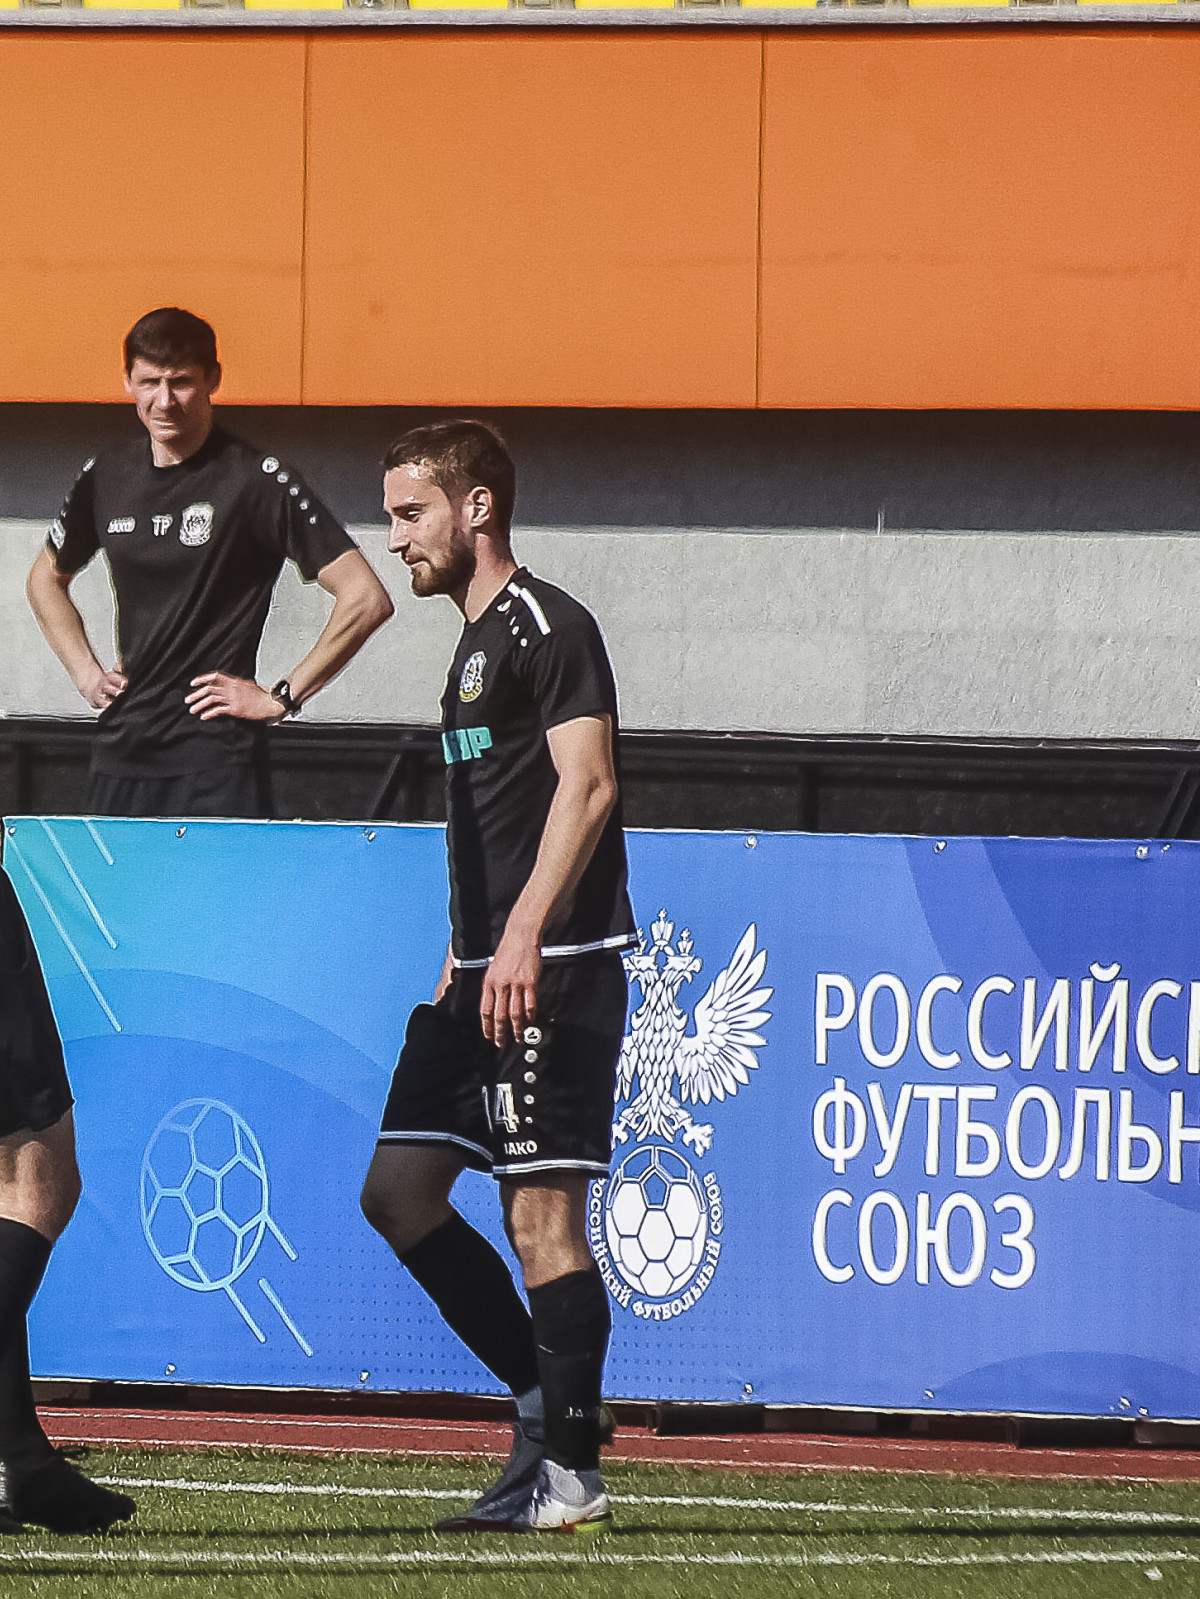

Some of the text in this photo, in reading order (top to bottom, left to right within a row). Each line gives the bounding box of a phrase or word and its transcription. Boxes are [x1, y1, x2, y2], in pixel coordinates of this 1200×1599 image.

[631, 1239, 723, 1321] ФУТБОЛЬНЫЙ
[702, 1170, 724, 1236] СОЮЗ
[811, 1189, 1037, 1289] СОЮЗ
